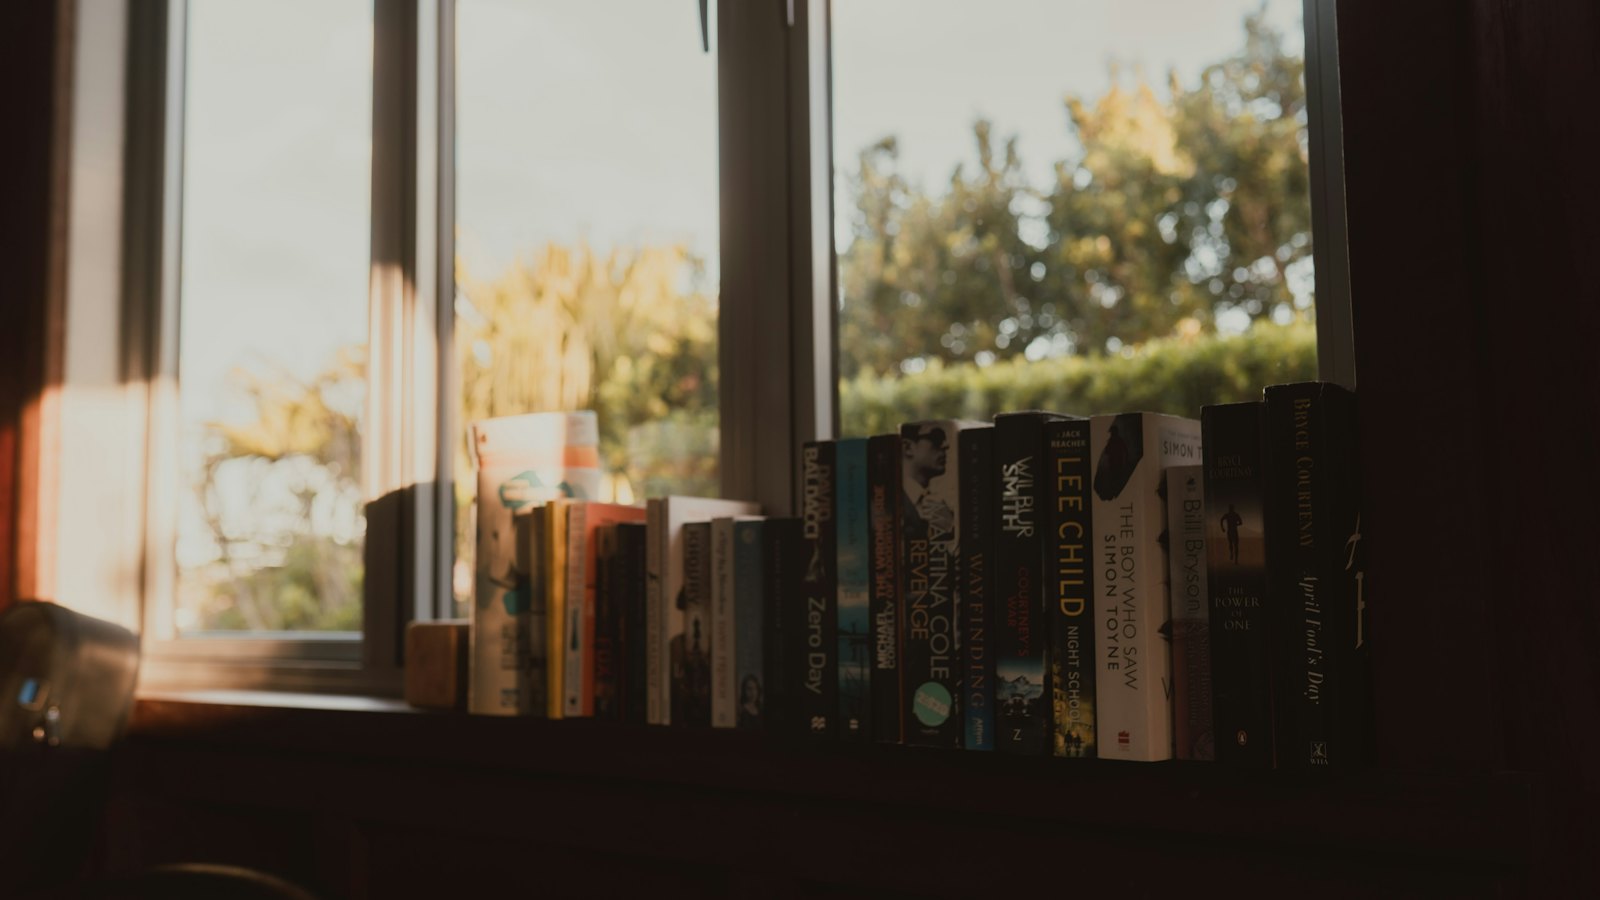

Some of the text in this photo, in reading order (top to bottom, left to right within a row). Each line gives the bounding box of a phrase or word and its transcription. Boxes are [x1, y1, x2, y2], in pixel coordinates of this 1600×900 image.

[1051, 440, 1086, 448] REACHER
[1061, 430, 1080, 438] JACK
[1163, 440, 1194, 459] SIMON
[803, 447, 820, 539] BALDACCI
[818, 465, 832, 522] DAVID
[1002, 463, 1020, 531] SMITH
[1014, 456, 1035, 538] WILBUR
[1057, 457, 1083, 513] LEE
[1294, 398, 1315, 548] BRYCE COURTENAY
[1183, 499, 1202, 531] Bill
[910, 539, 929, 640] REVENGE
[928, 501, 949, 608] MARTINA
[1058, 521, 1086, 617] CHILD
[1185, 539, 1204, 611] Bryson
[969, 552, 985, 708] WAYFINDING
[1007, 595, 1018, 627] WAR
[1018, 566, 1030, 657] COURTNEY'S
[1104, 535, 1120, 670] SIMON TOYNE
[1120, 503, 1138, 691] THE BOY WHO SAW
[1215, 597, 1260, 608] POWER
[1223, 619, 1251, 630] ONE
[804, 597, 827, 694] Zero Day
[876, 612, 887, 669] MICHAEL
[929, 615, 950, 679] COLE
[1298, 571, 1324, 705] April Fool's Day
[1067, 625, 1081, 725] NIGHT SCHOOL
[1012, 729, 1022, 741] Z
